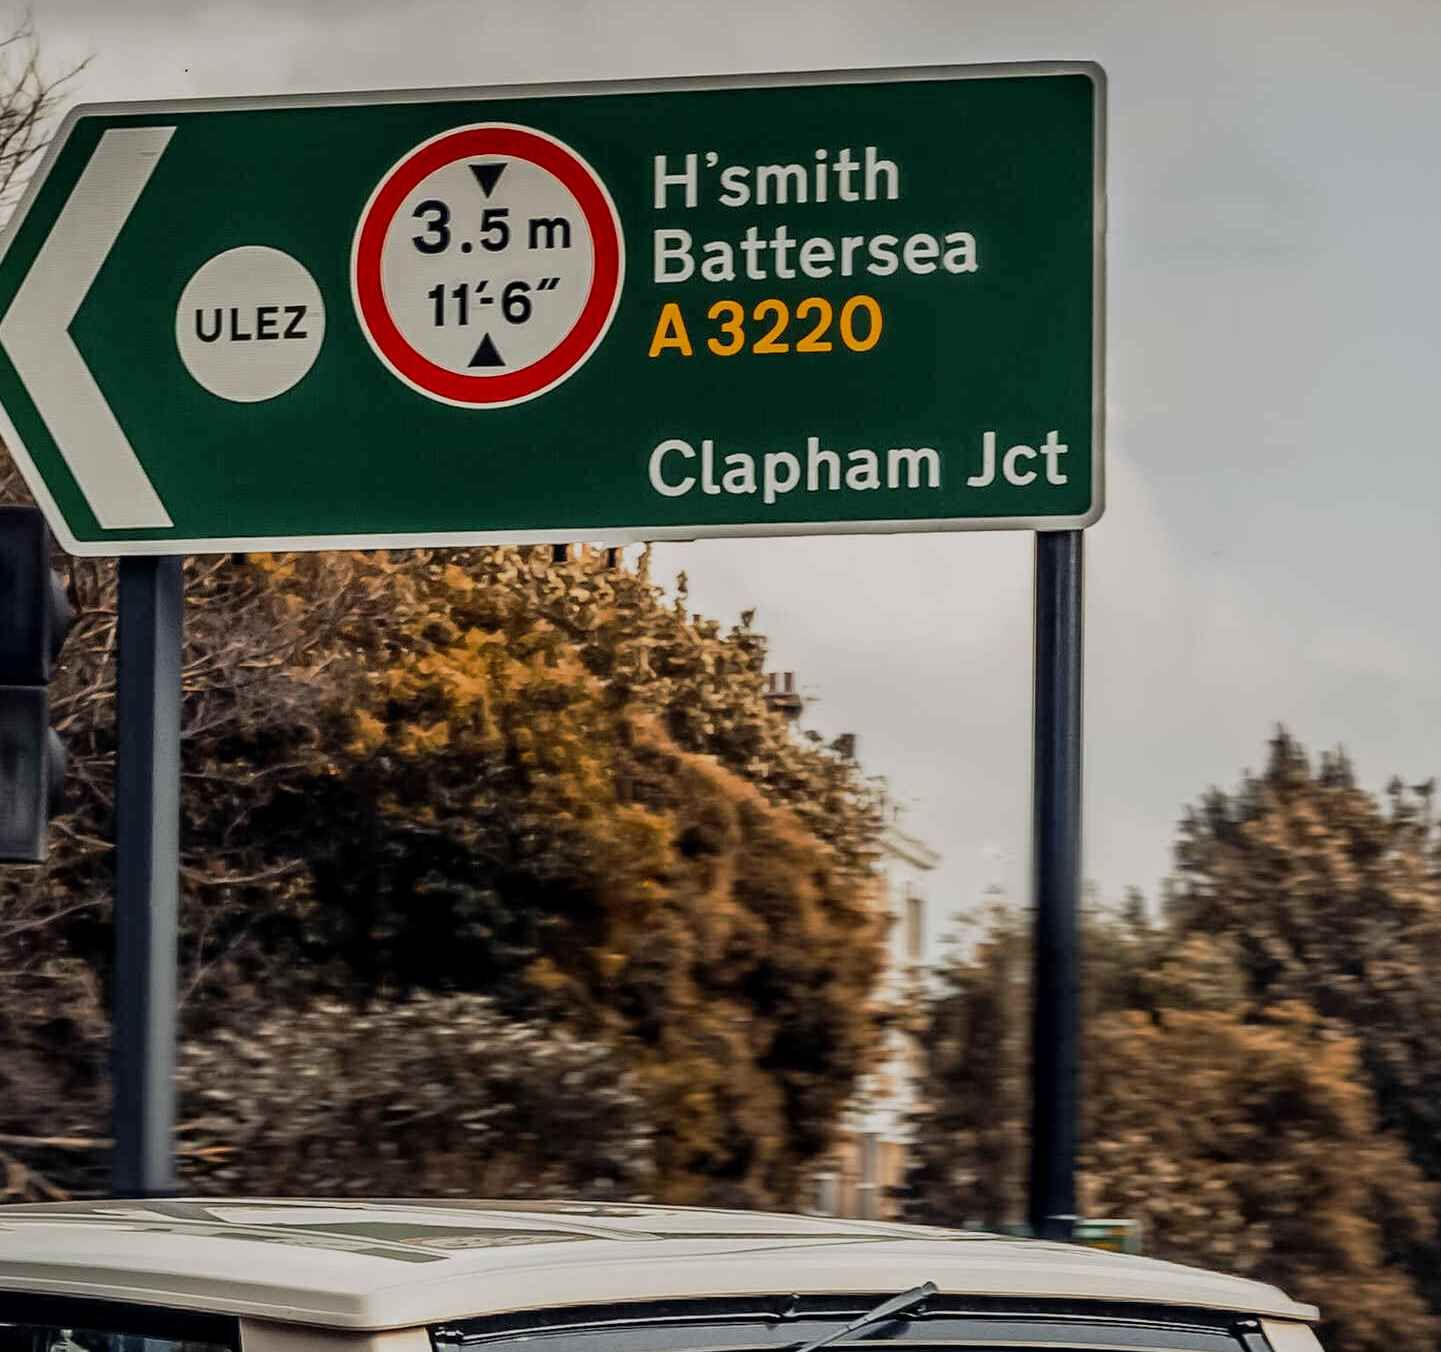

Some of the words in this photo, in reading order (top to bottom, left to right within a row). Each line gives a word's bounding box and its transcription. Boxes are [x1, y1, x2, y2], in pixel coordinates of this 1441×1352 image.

[654, 146, 900, 209] H'smith
[411, 199, 511, 255] 3.5
[527, 217, 572, 250] m
[654, 225, 980, 283] Battersea
[195, 304, 308, 343] ULEZ
[648, 436, 941, 505] Clapham
[965, 430, 1069, 487] Jct
